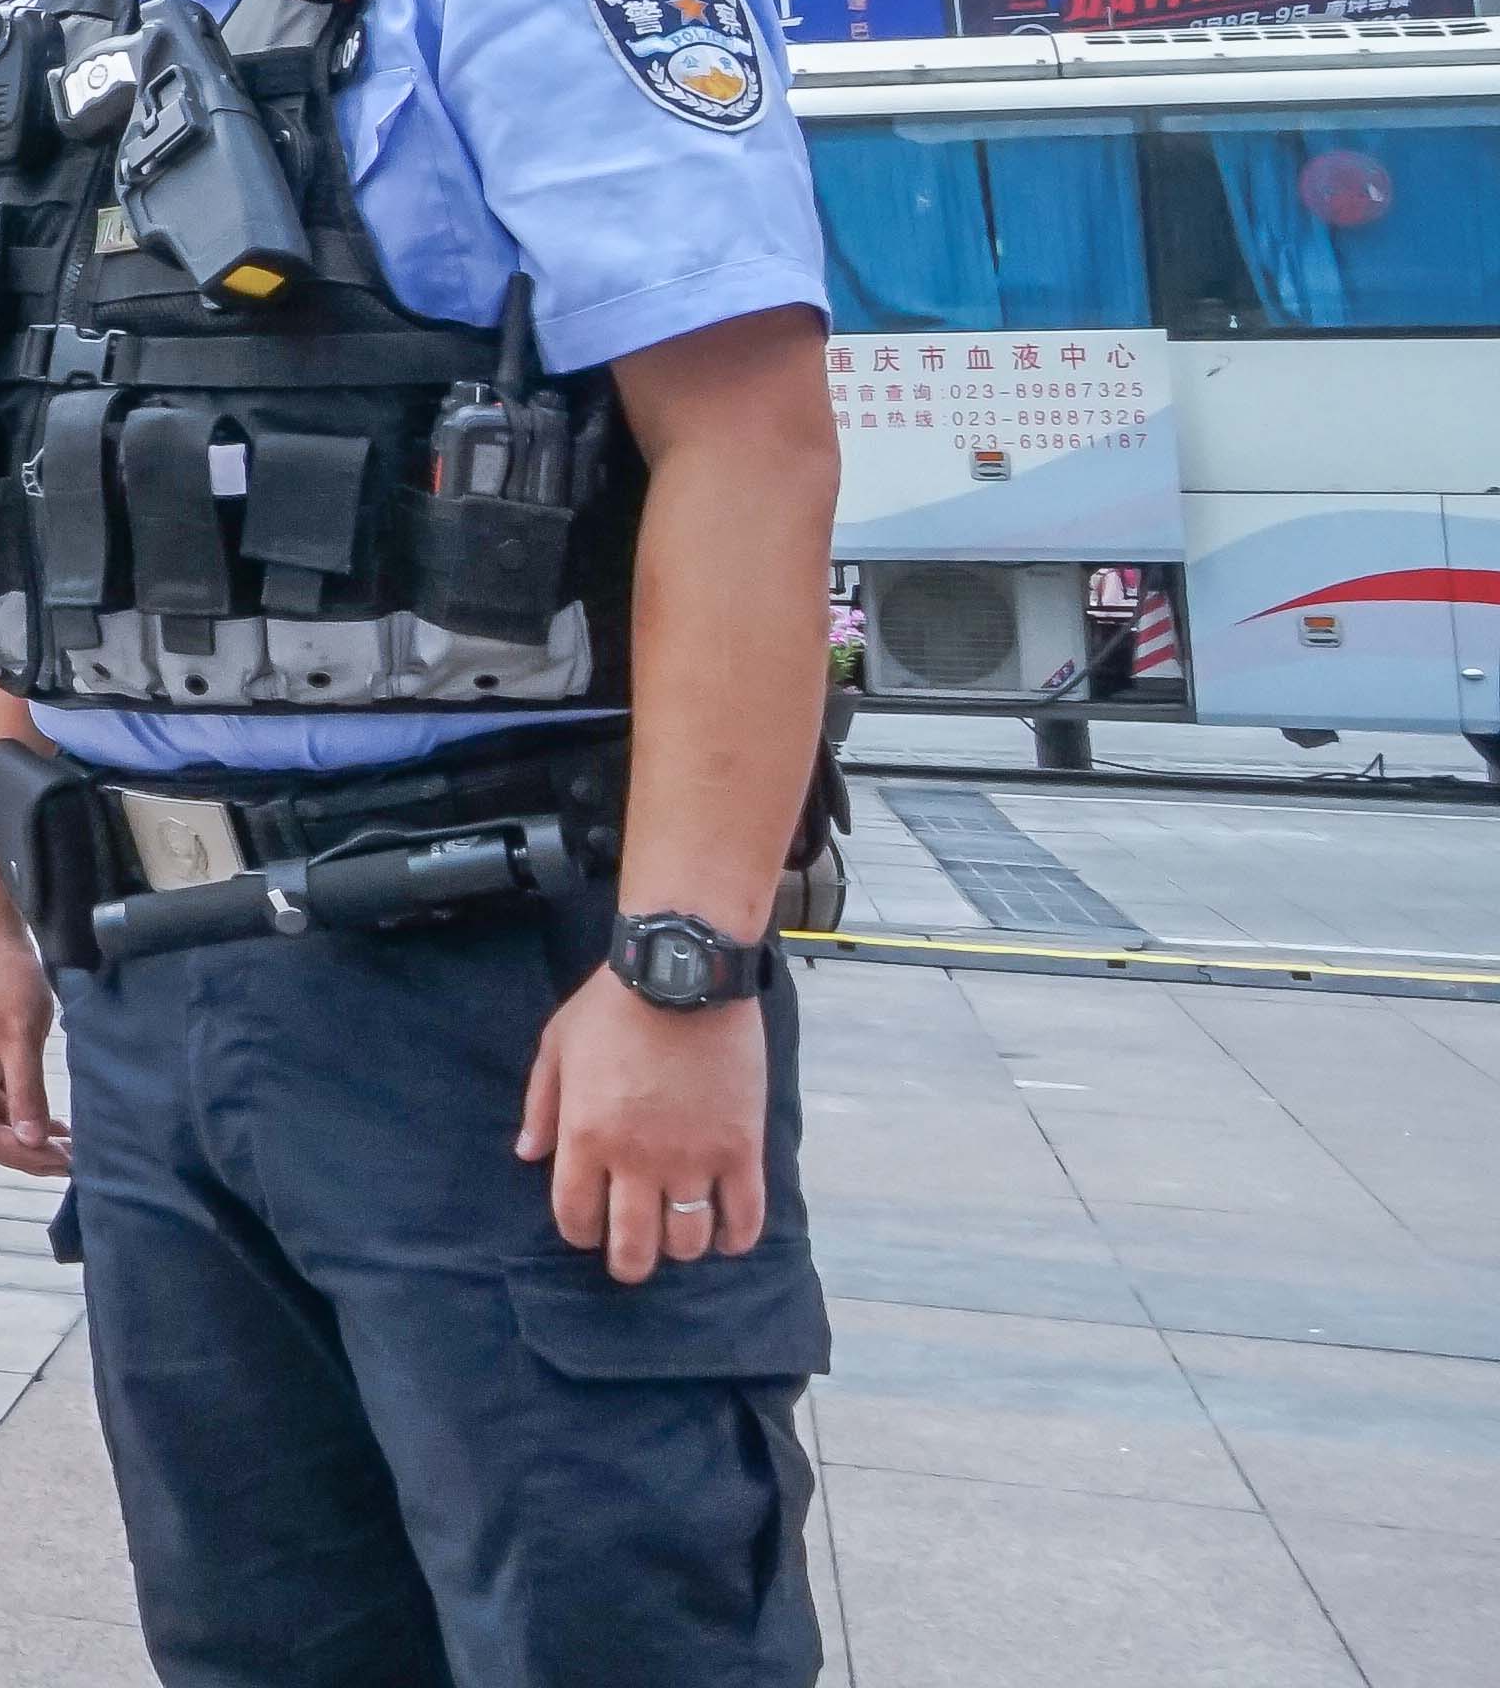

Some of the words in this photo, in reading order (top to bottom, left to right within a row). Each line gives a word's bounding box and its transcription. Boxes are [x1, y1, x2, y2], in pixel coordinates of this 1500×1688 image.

[621, 0, 744, 37] 警察
[827, 343, 1137, 374] 重庆市血液中心
[953, 433, 1148, 450] 023-63861187
